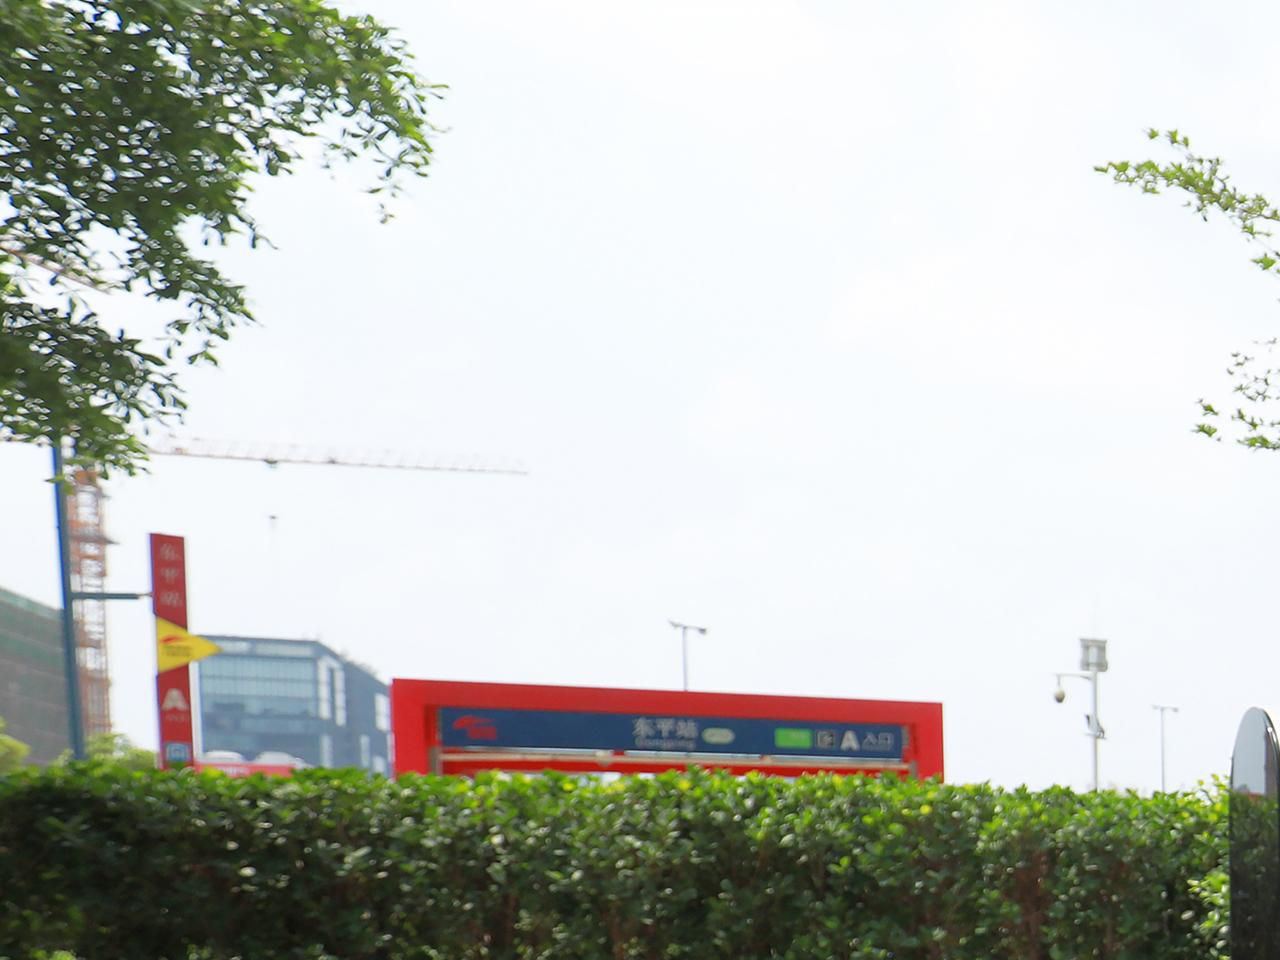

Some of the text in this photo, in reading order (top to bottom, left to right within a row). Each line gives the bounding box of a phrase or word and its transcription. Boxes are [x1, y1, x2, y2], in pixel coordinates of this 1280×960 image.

[161, 687, 189, 711] A
[632, 717, 698, 739] 东平站
[840, 729, 860, 752] A
